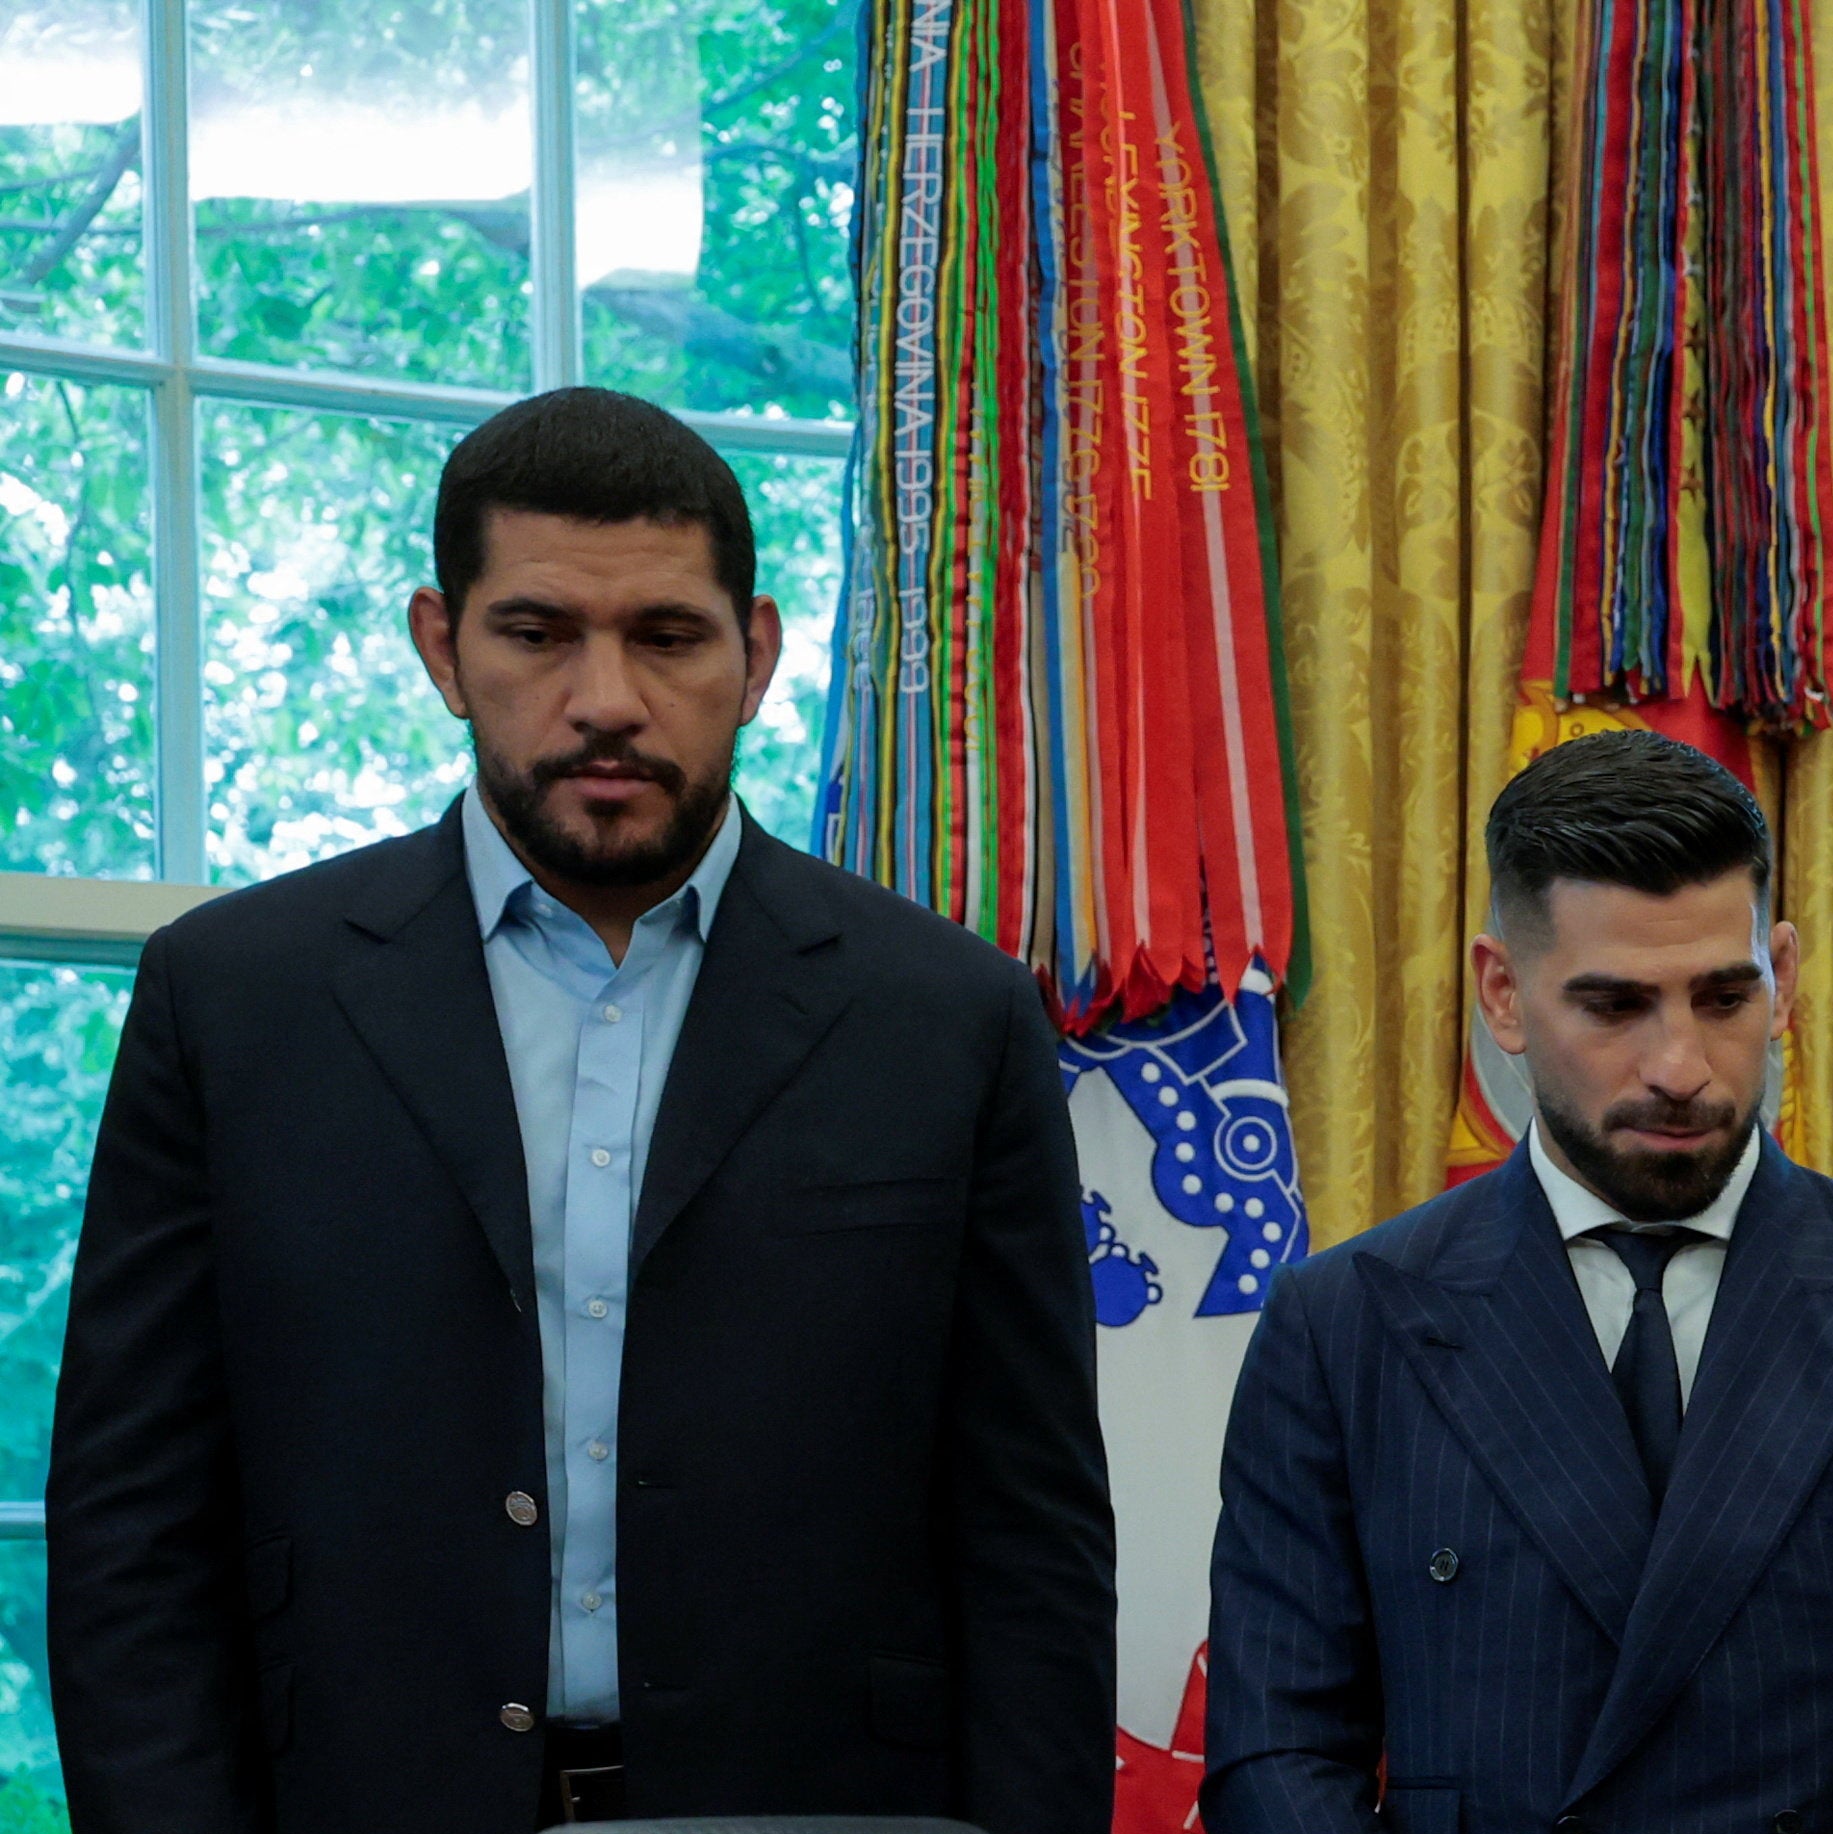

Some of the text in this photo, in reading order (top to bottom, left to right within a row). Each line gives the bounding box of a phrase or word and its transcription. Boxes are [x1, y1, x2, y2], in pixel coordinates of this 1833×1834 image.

[894, 107, 948, 436] HERZEGOVINA
[1154, 120, 1231, 493] YORKTOWN 1781
[894, 449, 933, 554] 1995
[898, 587, 931, 694] 1999
